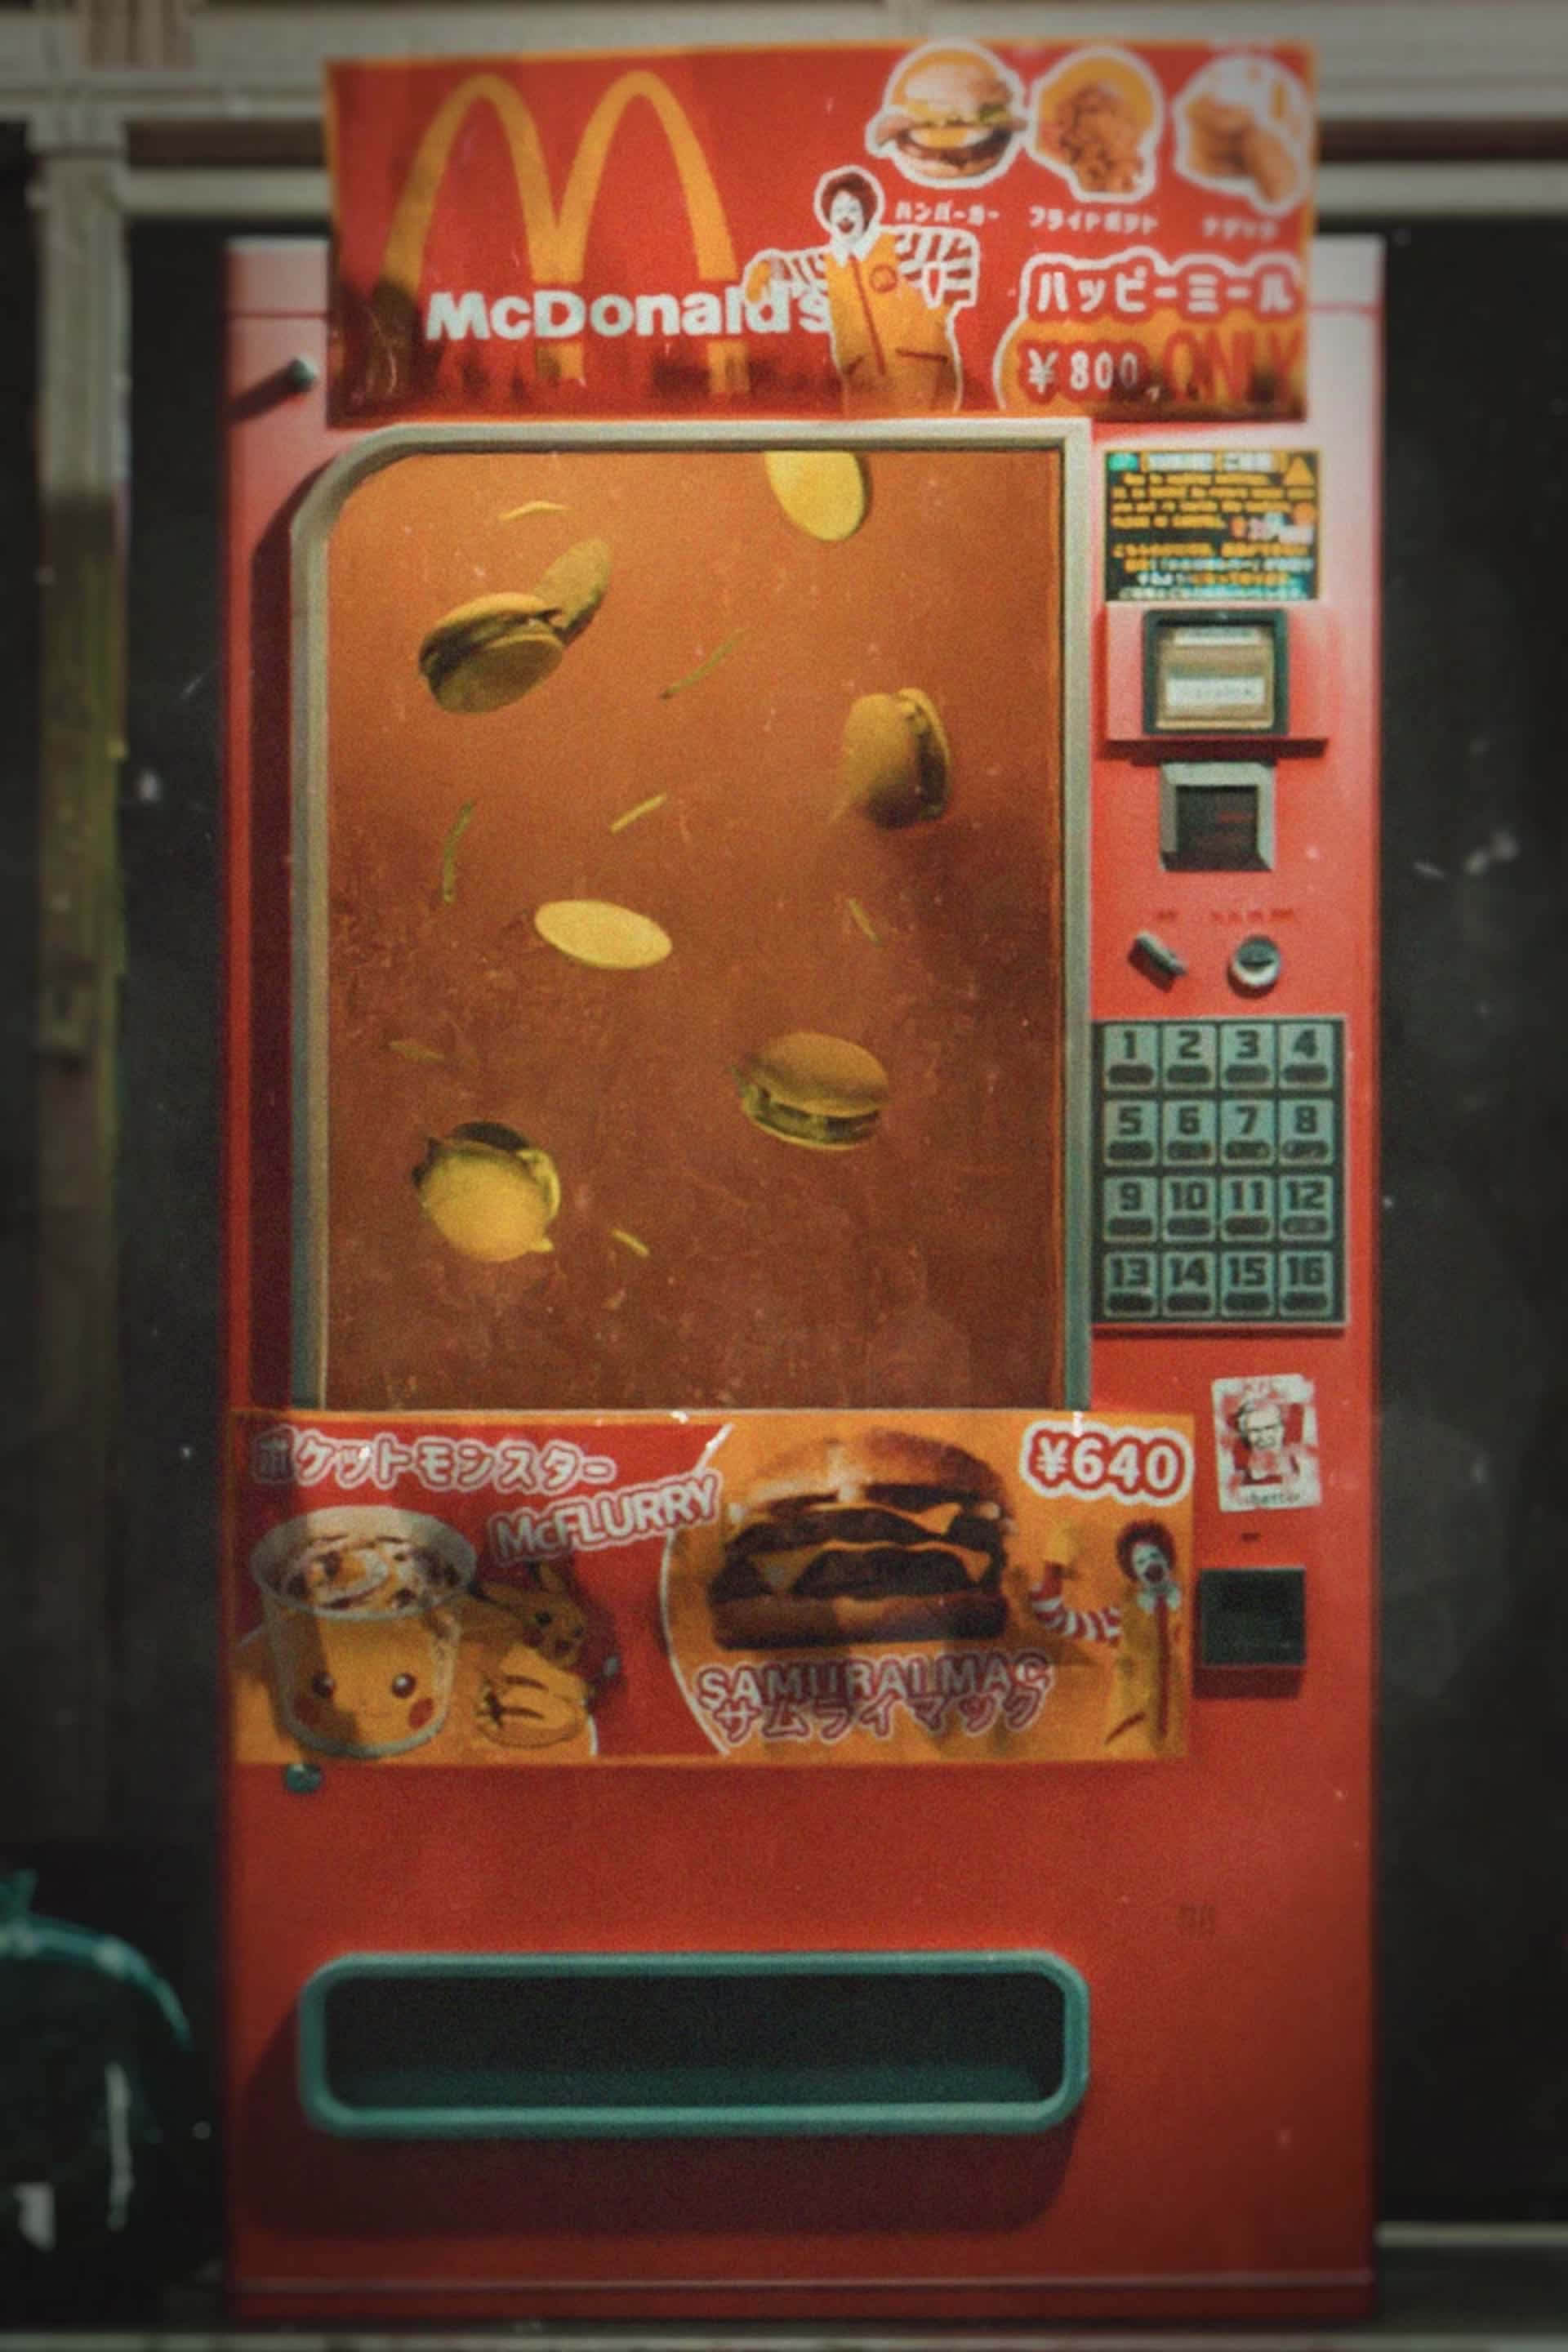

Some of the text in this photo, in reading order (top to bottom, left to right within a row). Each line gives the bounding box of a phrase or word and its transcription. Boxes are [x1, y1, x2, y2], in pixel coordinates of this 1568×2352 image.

[1037, 268, 1294, 314] ハッピーミール
[1123, 1031, 1137, 1059] 1
[1178, 1031, 1200, 1059] 2
[1236, 1030, 1258, 1059] 3
[1293, 1030, 1318, 1058] 4
[1119, 1107, 1142, 1135] 5
[1178, 1107, 1200, 1135] 6
[1236, 1107, 1258, 1135] 7
[1294, 1106, 1317, 1135] 8
[1120, 1183, 1142, 1211] 9
[1170, 1183, 1208, 1210] 10
[1232, 1181, 1264, 1210] 11
[1285, 1182, 1325, 1210] 12
[1111, 1258, 1148, 1287] 13
[1170, 1258, 1208, 1286] 14
[1228, 1258, 1266, 1286] 15
[1286, 1257, 1324, 1285] 16
[1038, 1437, 1178, 1490] ¥640
[495, 1478, 716, 1554] McFLURRY
[702, 1654, 1048, 1708] SAMURAI MAC
[717, 1690, 1039, 1740] サムライマック
